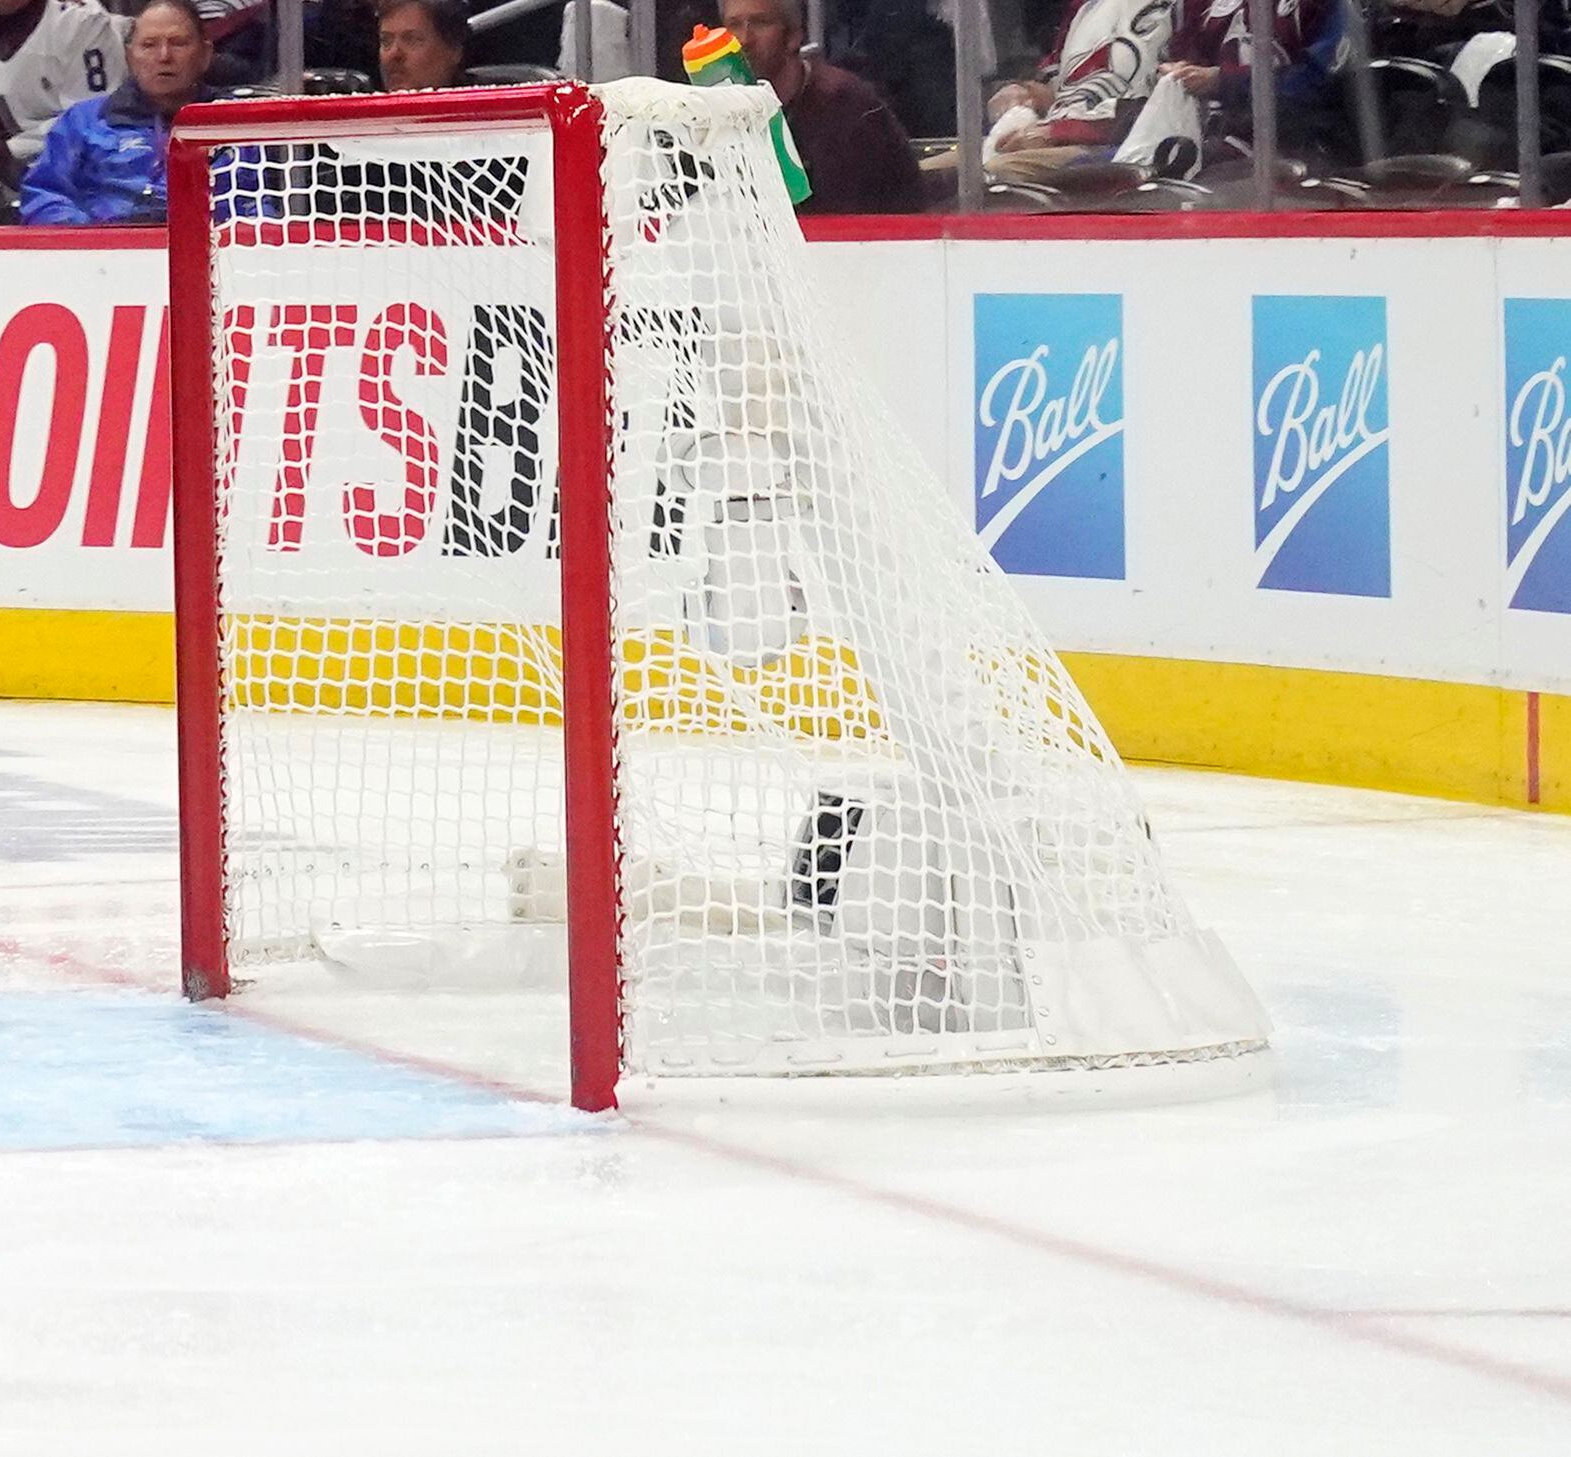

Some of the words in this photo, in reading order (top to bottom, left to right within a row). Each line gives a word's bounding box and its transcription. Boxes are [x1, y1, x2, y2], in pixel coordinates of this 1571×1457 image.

[83, 47, 107, 93] 8
[979, 337, 1122, 499] Ball
[1257, 342, 1383, 510] Ball
